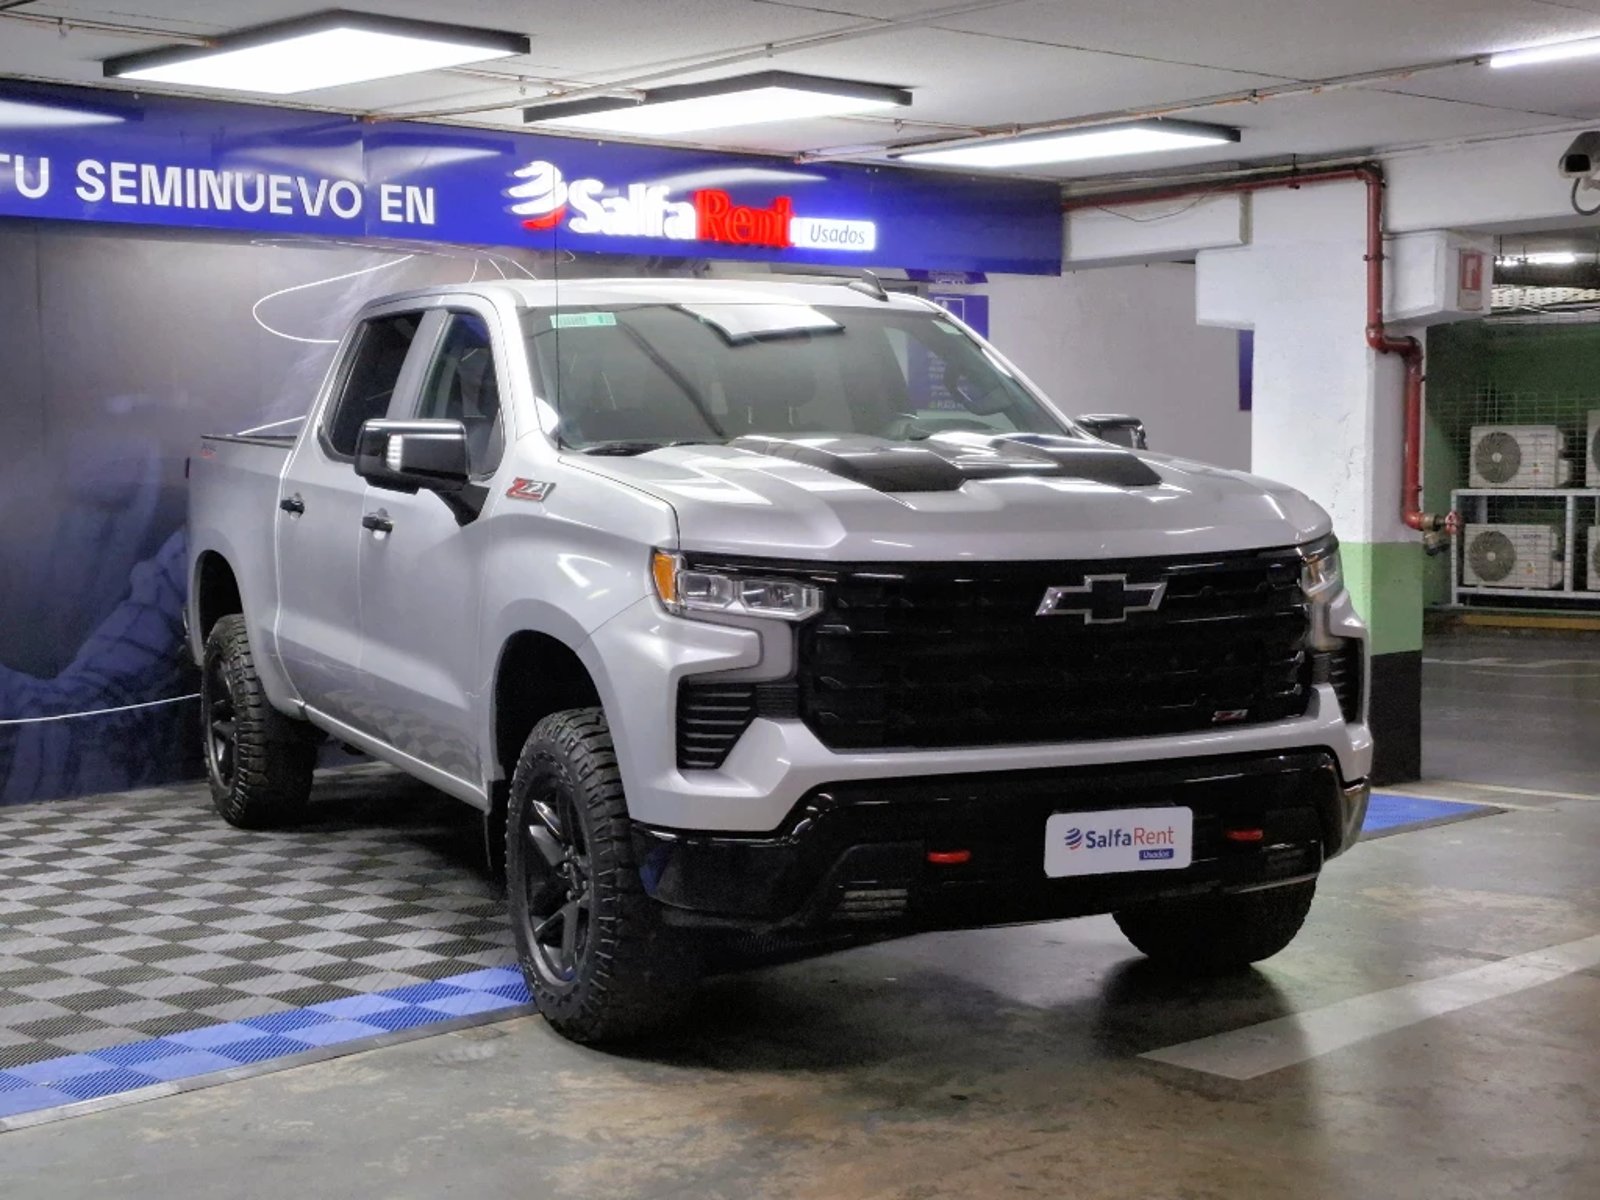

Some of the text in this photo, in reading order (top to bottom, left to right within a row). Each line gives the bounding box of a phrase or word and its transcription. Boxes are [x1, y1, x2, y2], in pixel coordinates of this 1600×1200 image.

[75, 158, 364, 219] SEMINUEVO
[380, 184, 435, 225] EN
[810, 223, 865, 244] Usados
